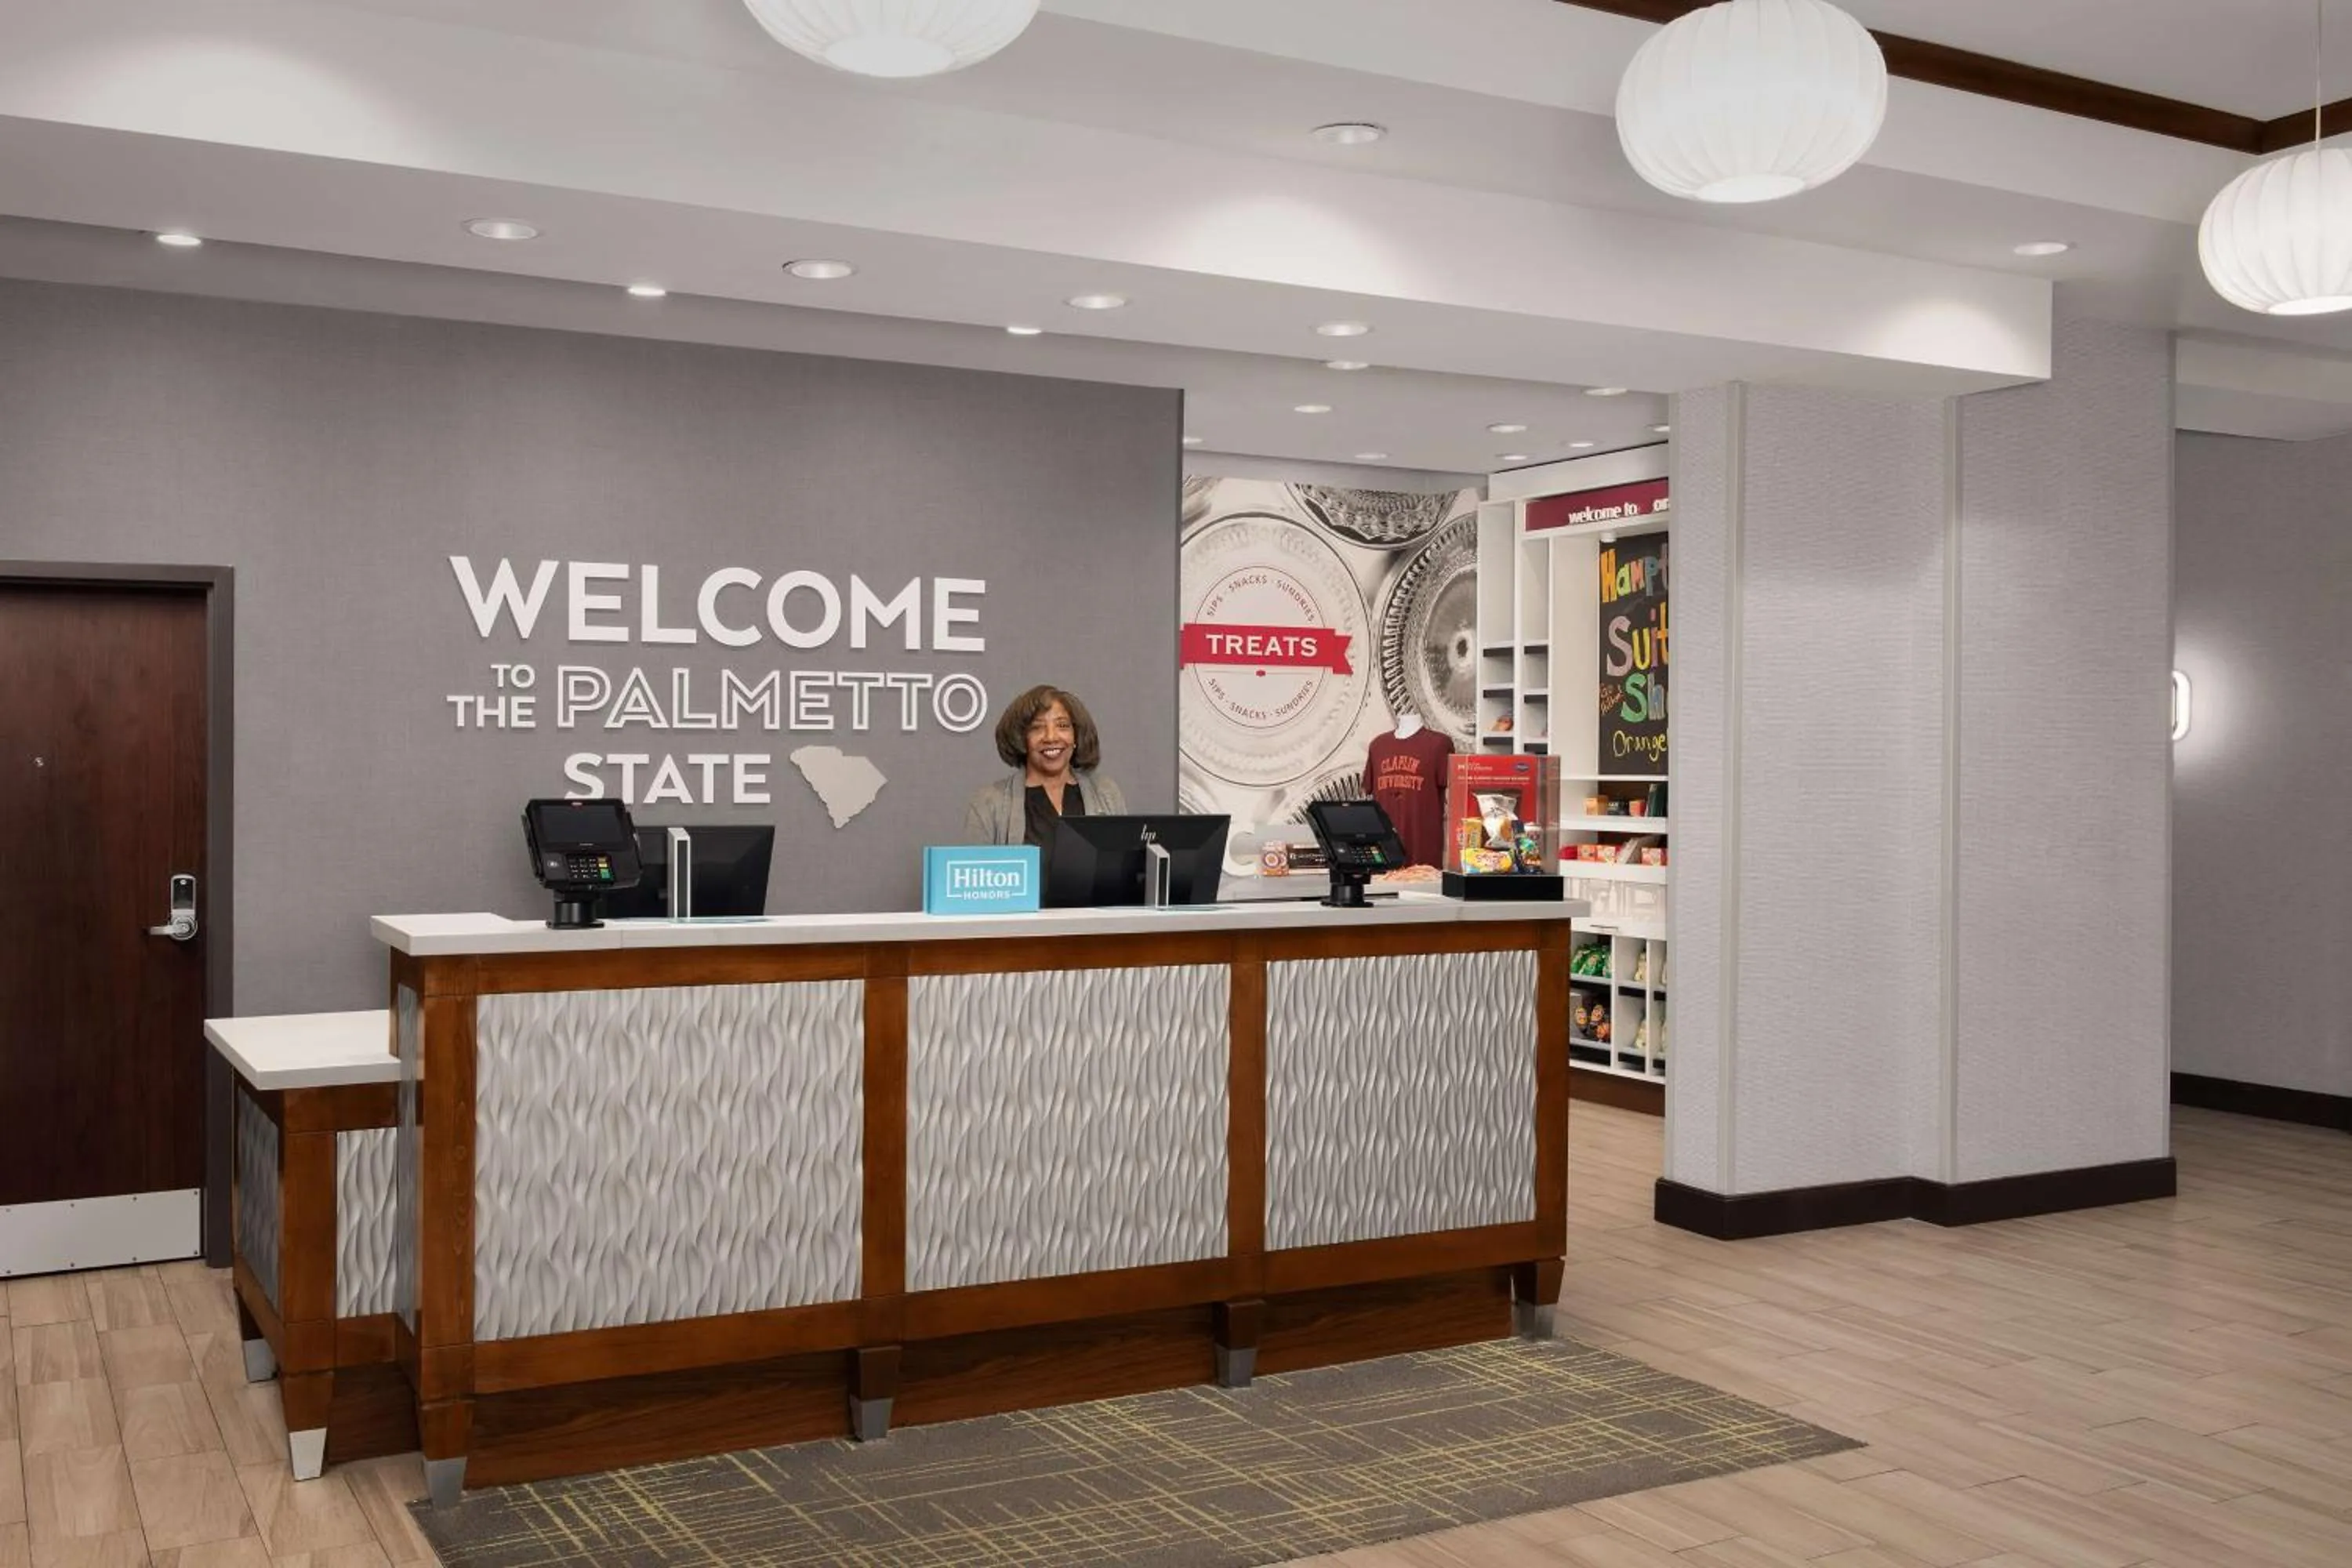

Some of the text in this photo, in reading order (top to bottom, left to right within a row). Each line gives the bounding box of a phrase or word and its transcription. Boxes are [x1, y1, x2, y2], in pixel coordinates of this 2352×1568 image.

[1568, 505, 1622, 524] welcome
[1624, 502, 1638, 517] to
[449, 555, 986, 652] WELCOME
[1207, 575, 1315, 622] SIPS SNACKS SUNDRIES
[1205, 633, 1319, 658] TREATS
[490, 664, 535, 688] TO
[447, 695, 536, 728] THE
[557, 665, 989, 733] PALMETTO
[1208, 678, 1313, 720] SIPS SNACKS SUNDRIES
[1621, 672, 1668, 723] Sh
[1613, 730, 1668, 762] Orange
[564, 752, 771, 804] STATE
[953, 867, 1020, 888] Hilton
[964, 889, 1011, 901] HONORS
